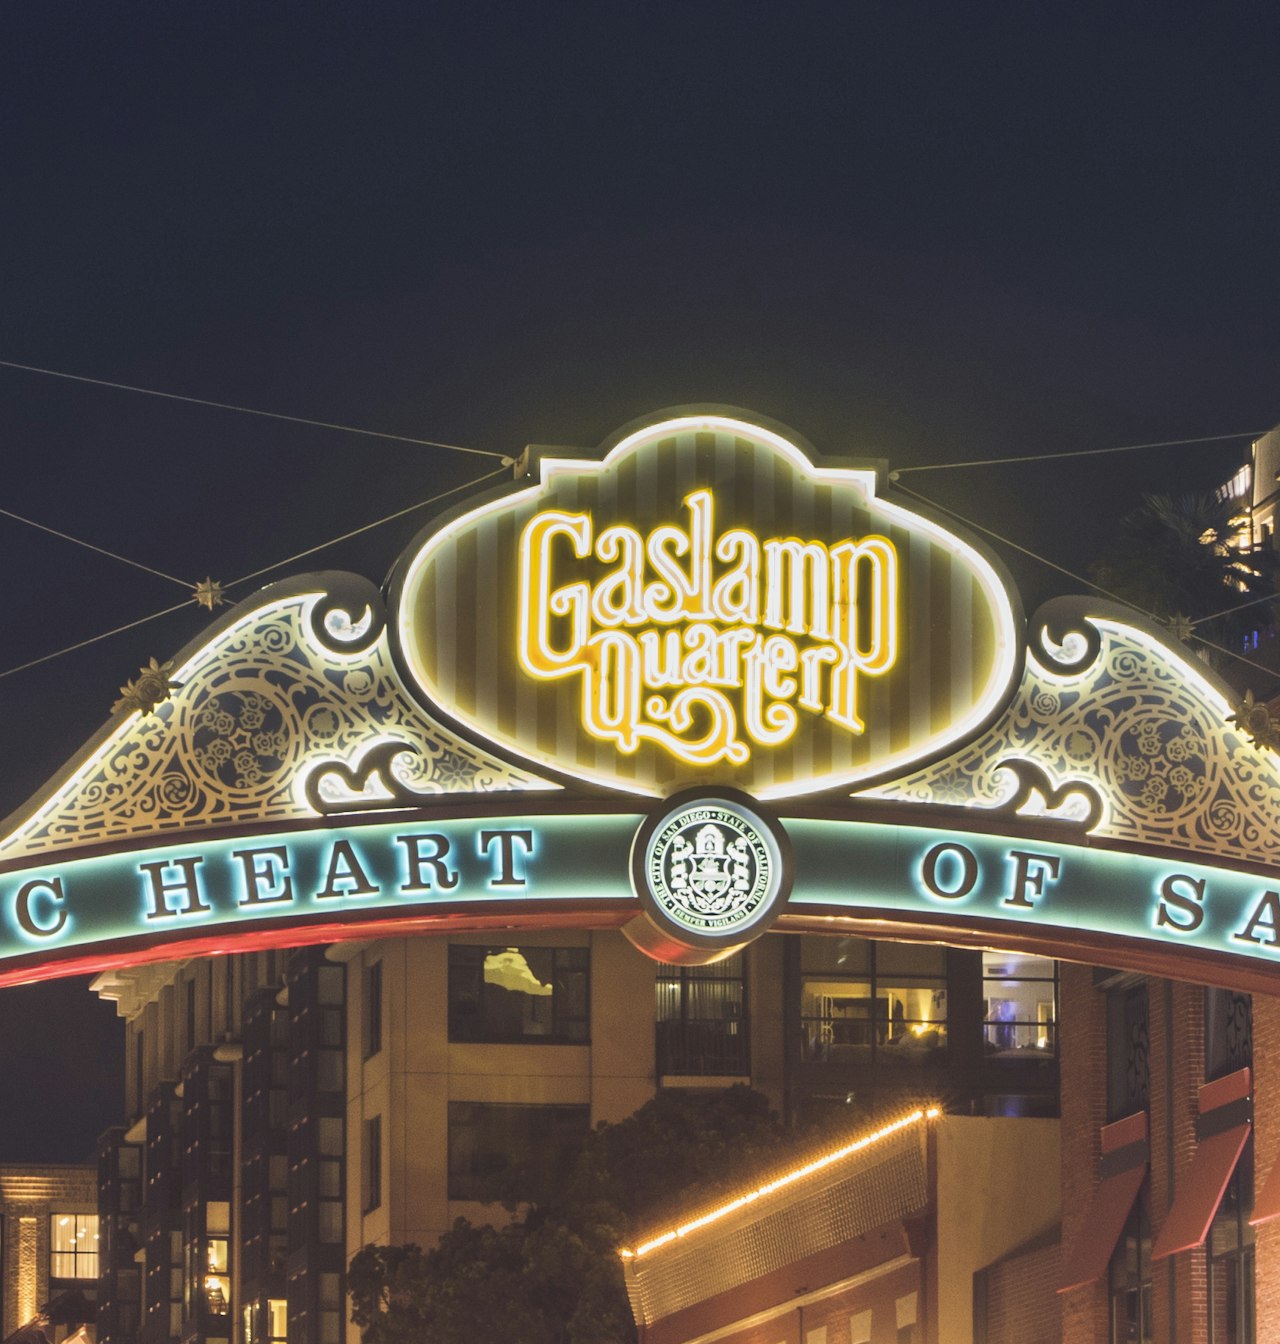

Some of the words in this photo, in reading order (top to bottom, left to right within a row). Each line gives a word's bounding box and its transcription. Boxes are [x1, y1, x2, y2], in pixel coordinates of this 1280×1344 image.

[520, 488, 898, 736] Gaslamp
[582, 622, 840, 765] Quarter
[680, 811, 711, 827] DIEGO
[717, 812, 747, 832] STATE
[661, 823, 679, 842] SAN
[748, 830, 762, 847] OF
[654, 841, 664, 856] OF
[140, 829, 534, 920] HEART
[921, 841, 1061, 908] OF
[650, 859, 662, 883] CITY
[750, 846, 770, 907] CALIFORNIA
[654, 883, 670, 906] THE
